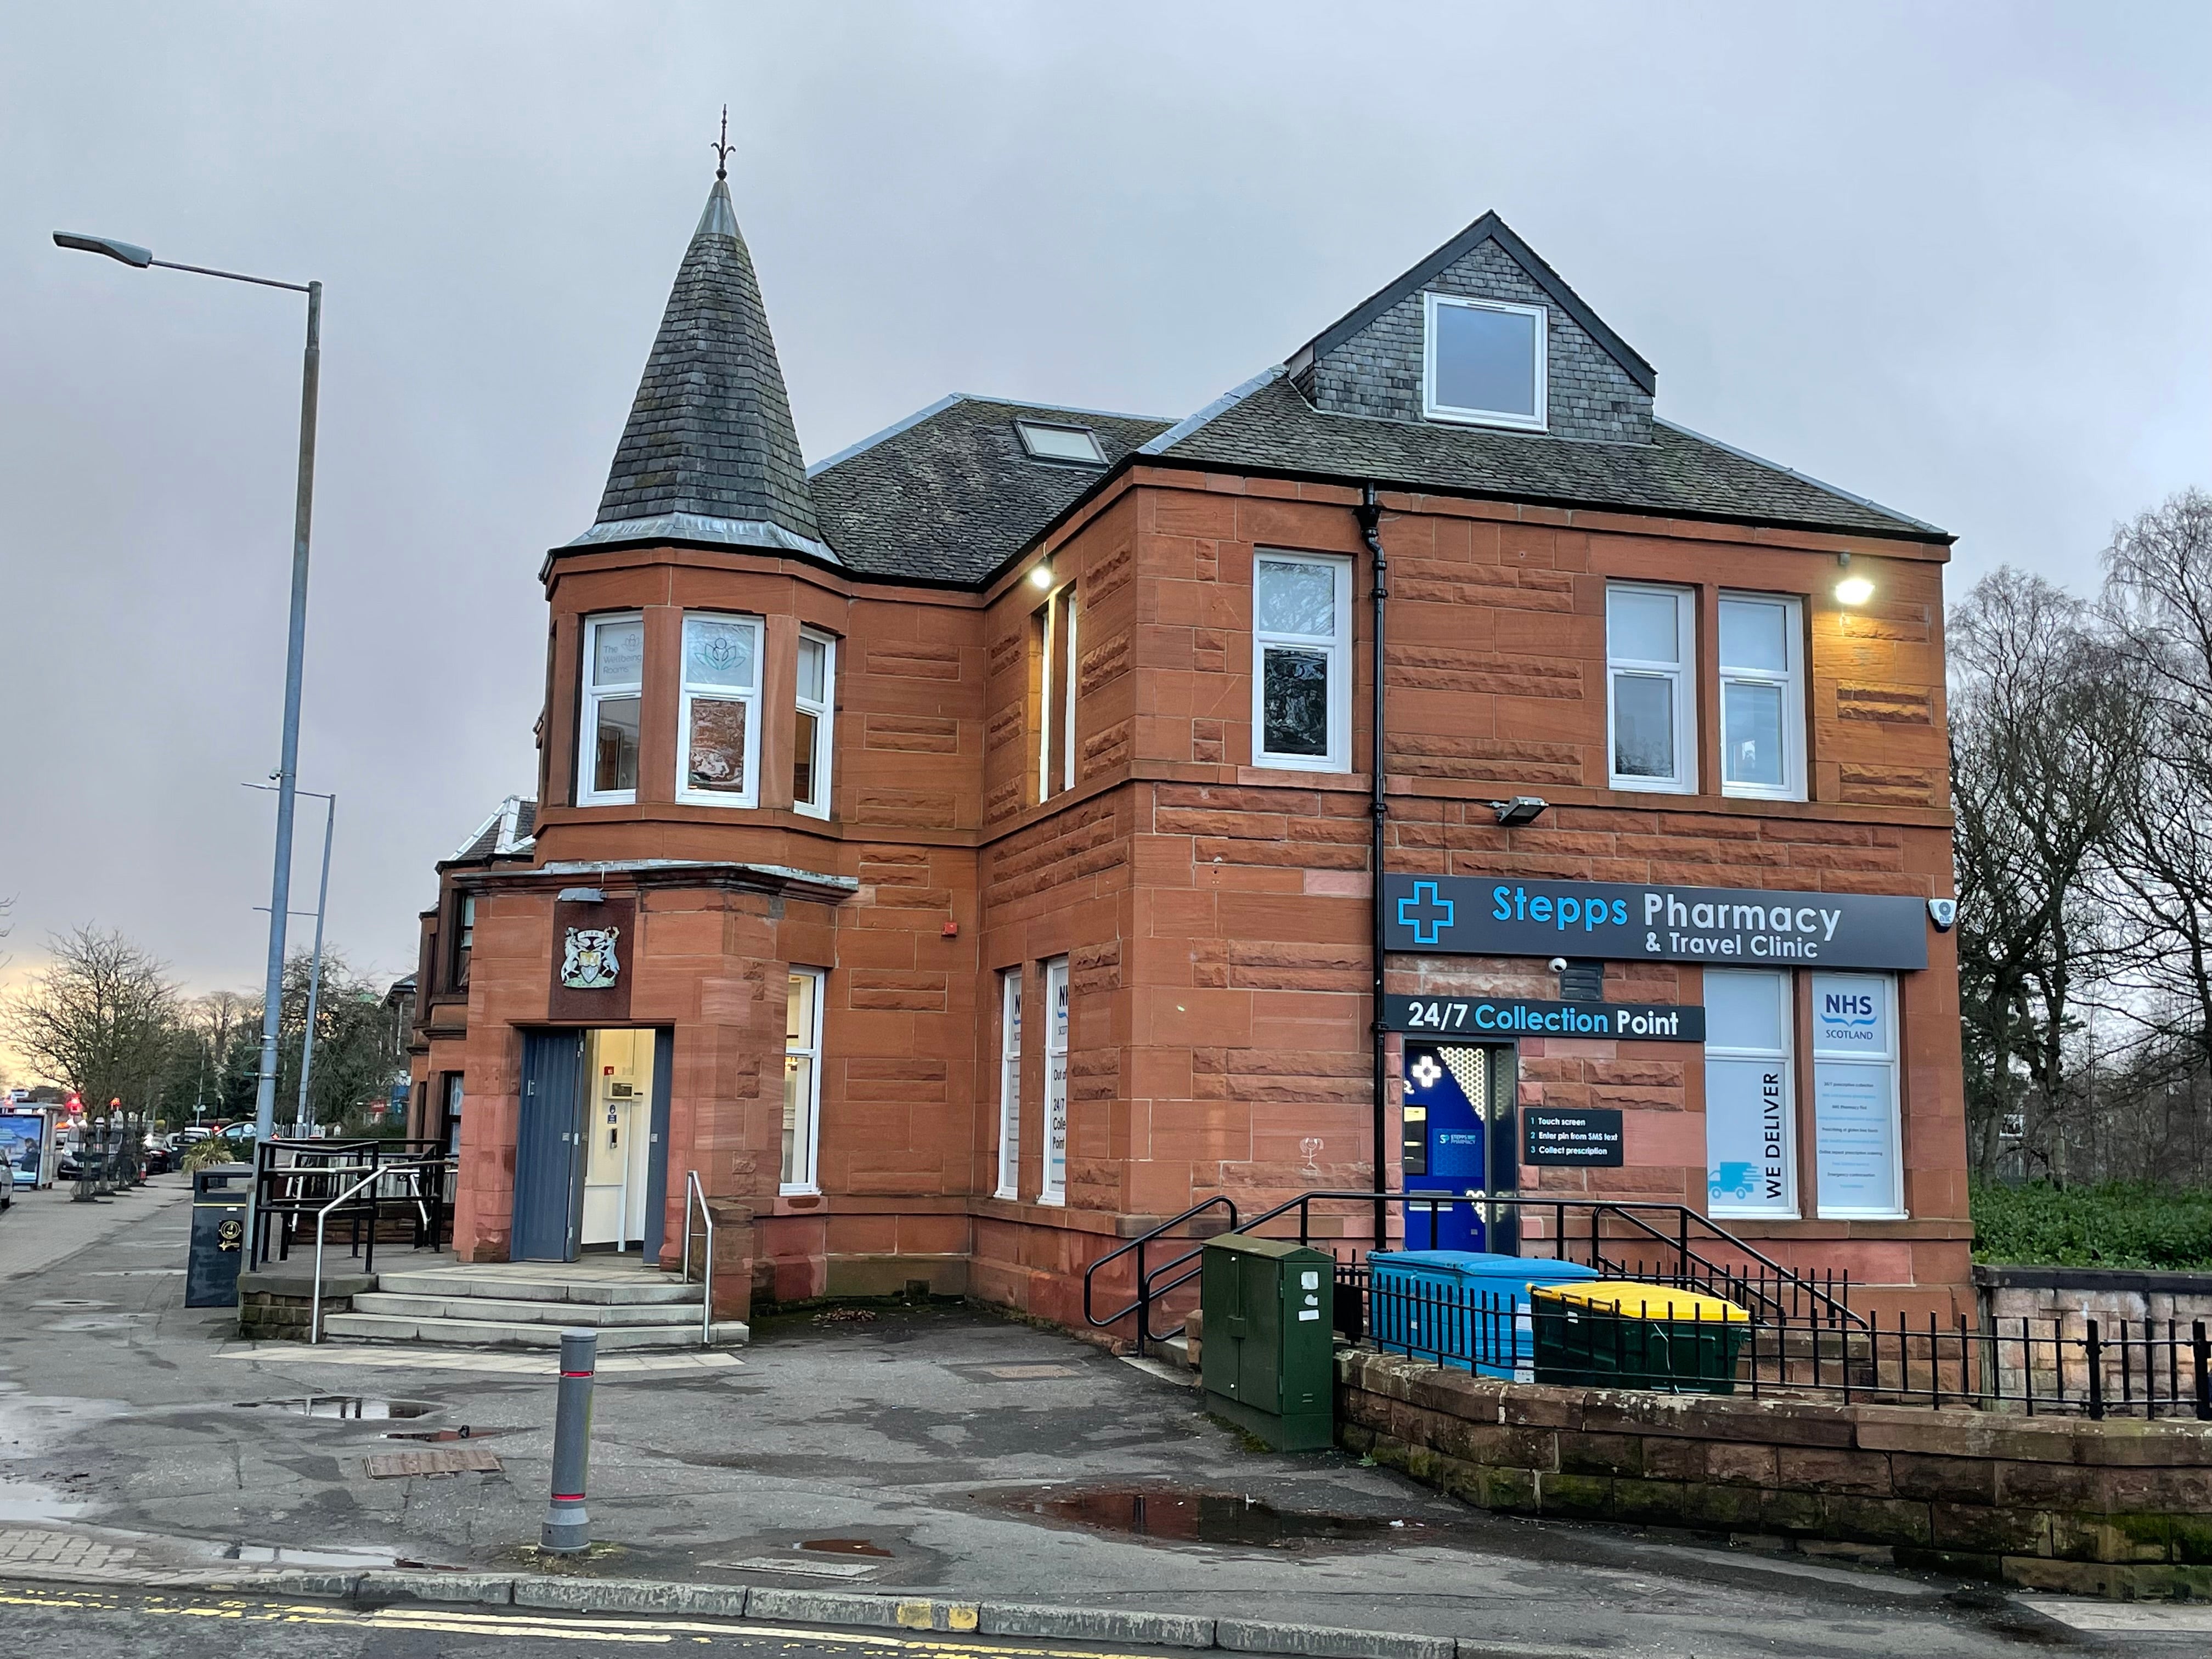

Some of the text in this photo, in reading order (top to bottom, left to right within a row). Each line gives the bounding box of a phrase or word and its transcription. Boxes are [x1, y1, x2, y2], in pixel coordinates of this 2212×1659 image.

[1492, 885, 1842, 941] Stepps Pharmacy
[1645, 932, 1818, 958] & Travel Clinic
[1826, 994, 1872, 1015] NHS
[1408, 1001, 1679, 1035] 24/7 Collection Point
[1826, 1029, 1873, 1040] SCOTLAND
[1538, 1117, 1560, 1125] Touch
[1558, 1132, 1570, 1141] pin
[1570, 1132, 1587, 1140] from
[1763, 1073, 1781, 1199] WE DELIVER
[1538, 1146, 1565, 1154] Collect
[1565, 1147, 1608, 1155] prescription
